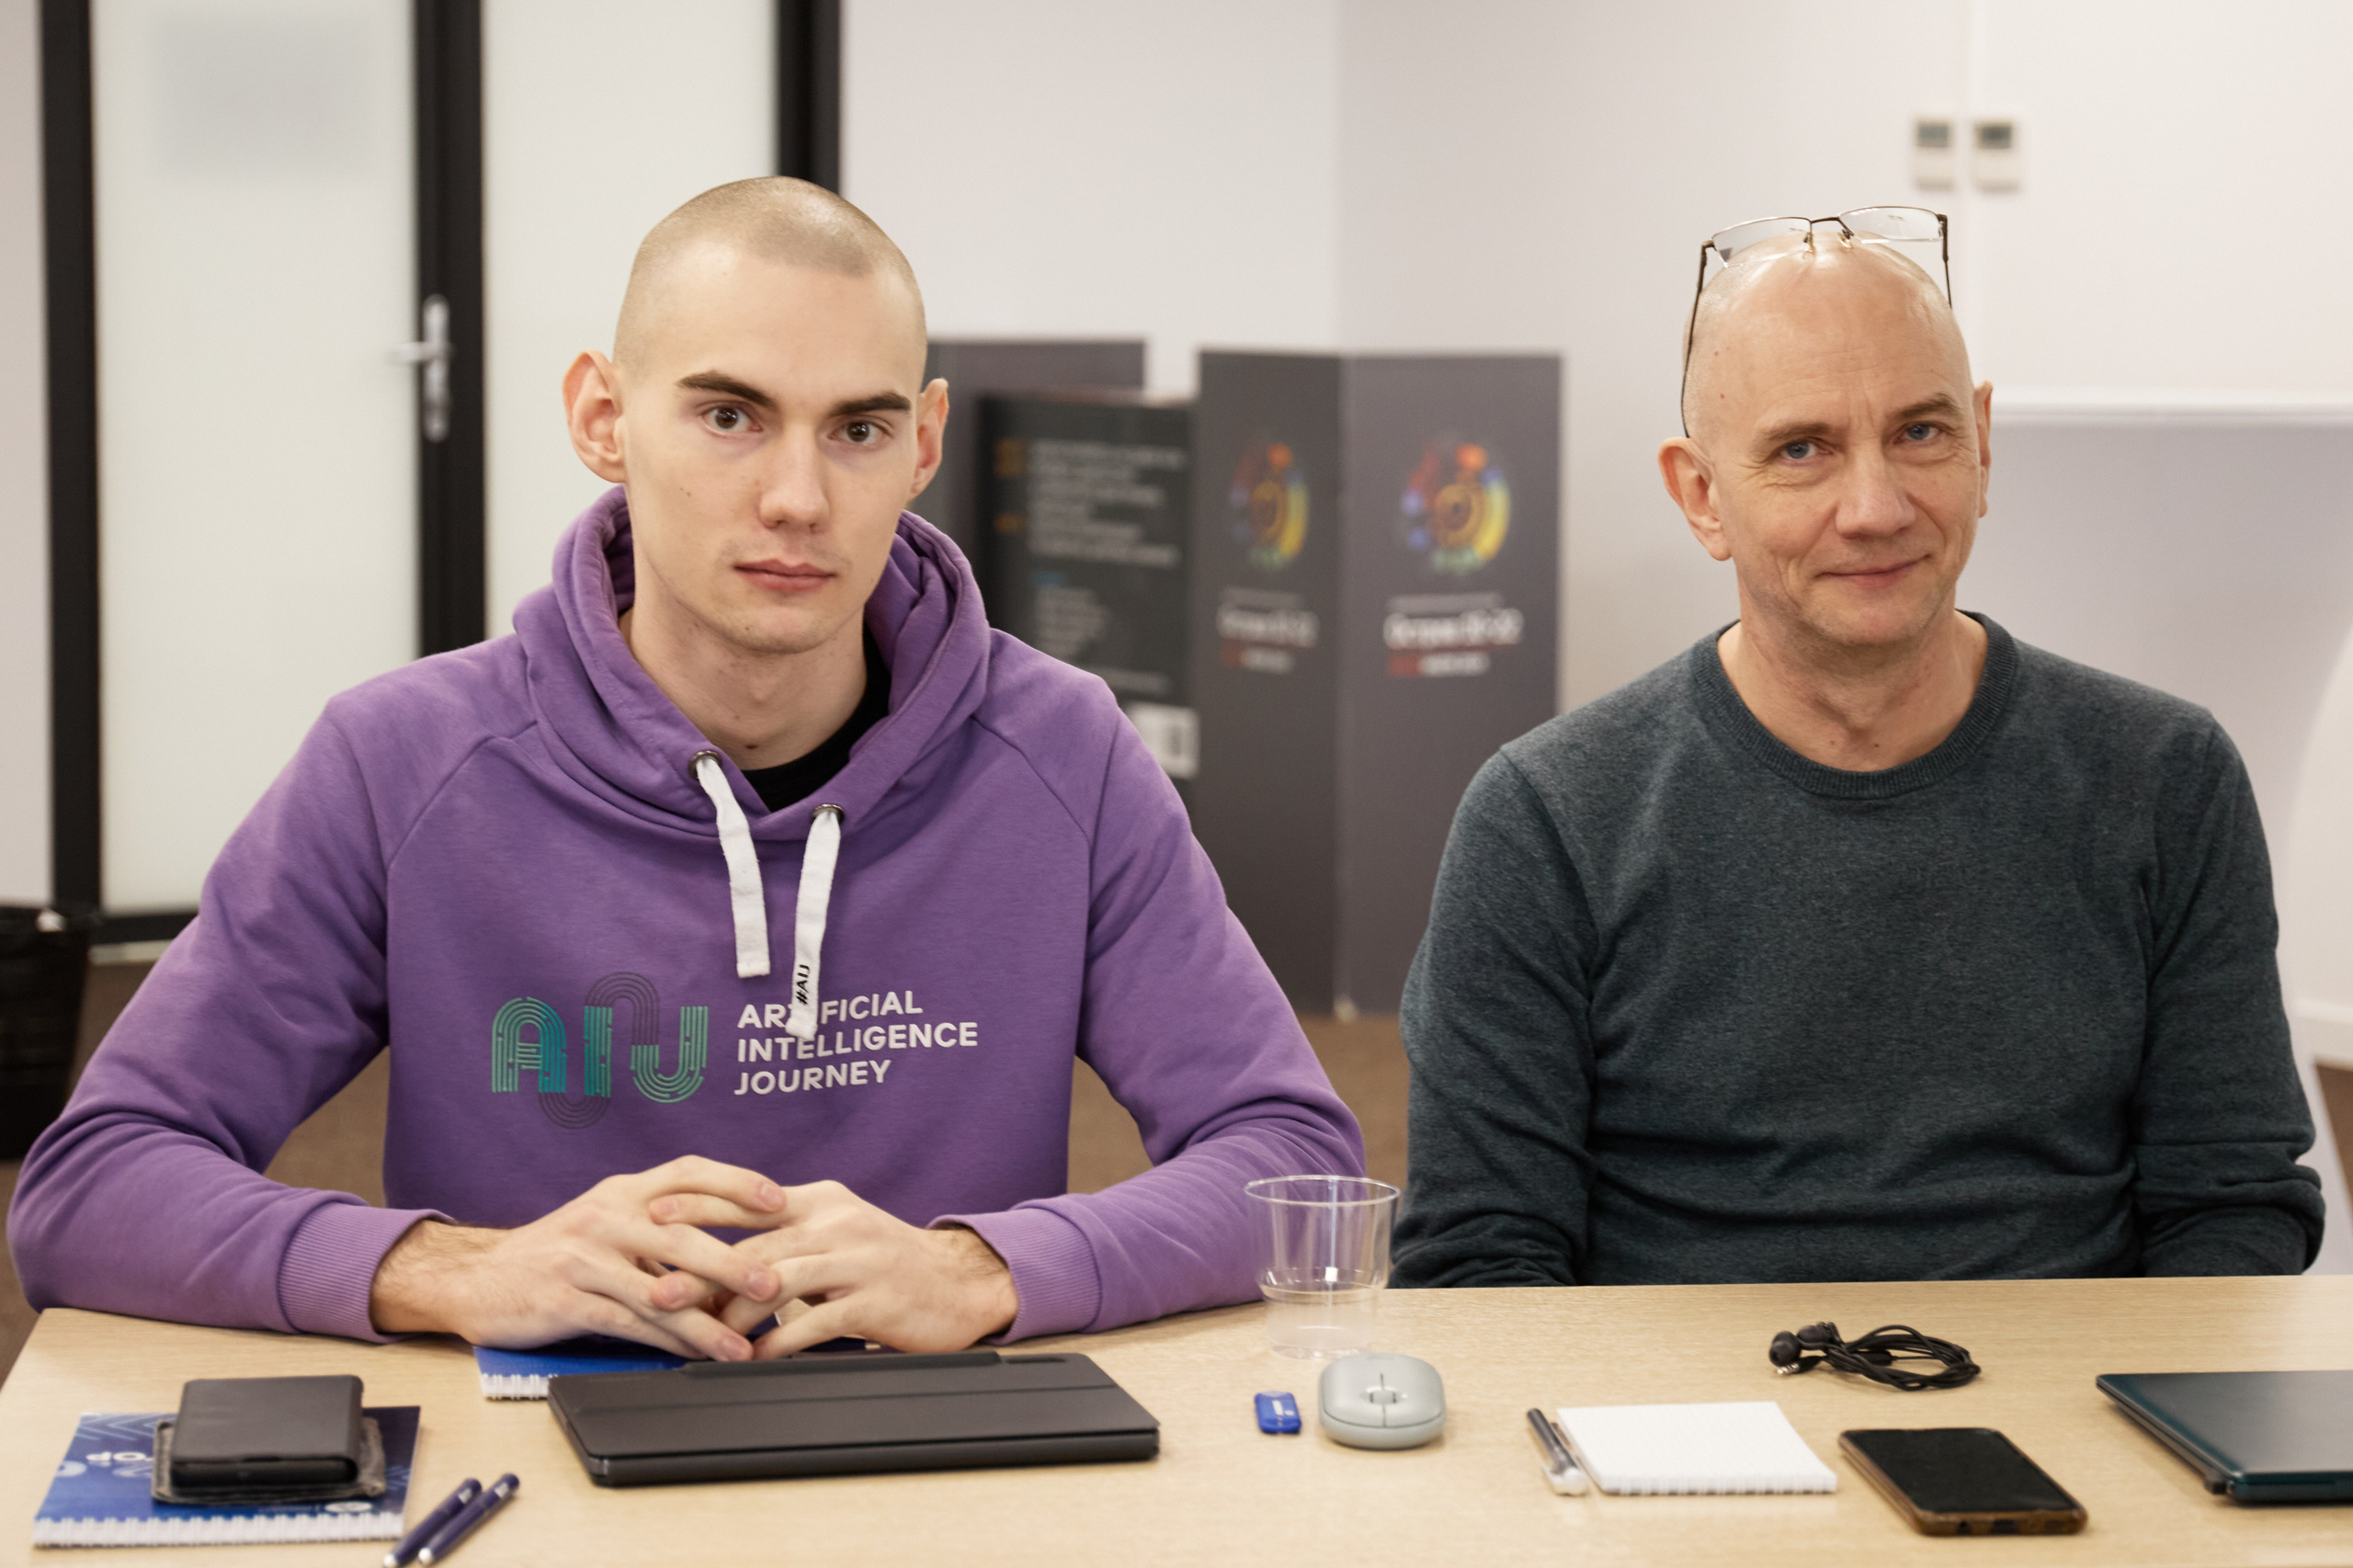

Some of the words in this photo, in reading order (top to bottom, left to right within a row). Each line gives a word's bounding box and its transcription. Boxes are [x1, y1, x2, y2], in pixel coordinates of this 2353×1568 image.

[796, 964, 811, 1006] #AIJ
[736, 990, 924, 1028] ARFICIAL
[737, 1022, 979, 1062] INTELLIGENCE
[733, 1059, 892, 1096] JOURNEY
